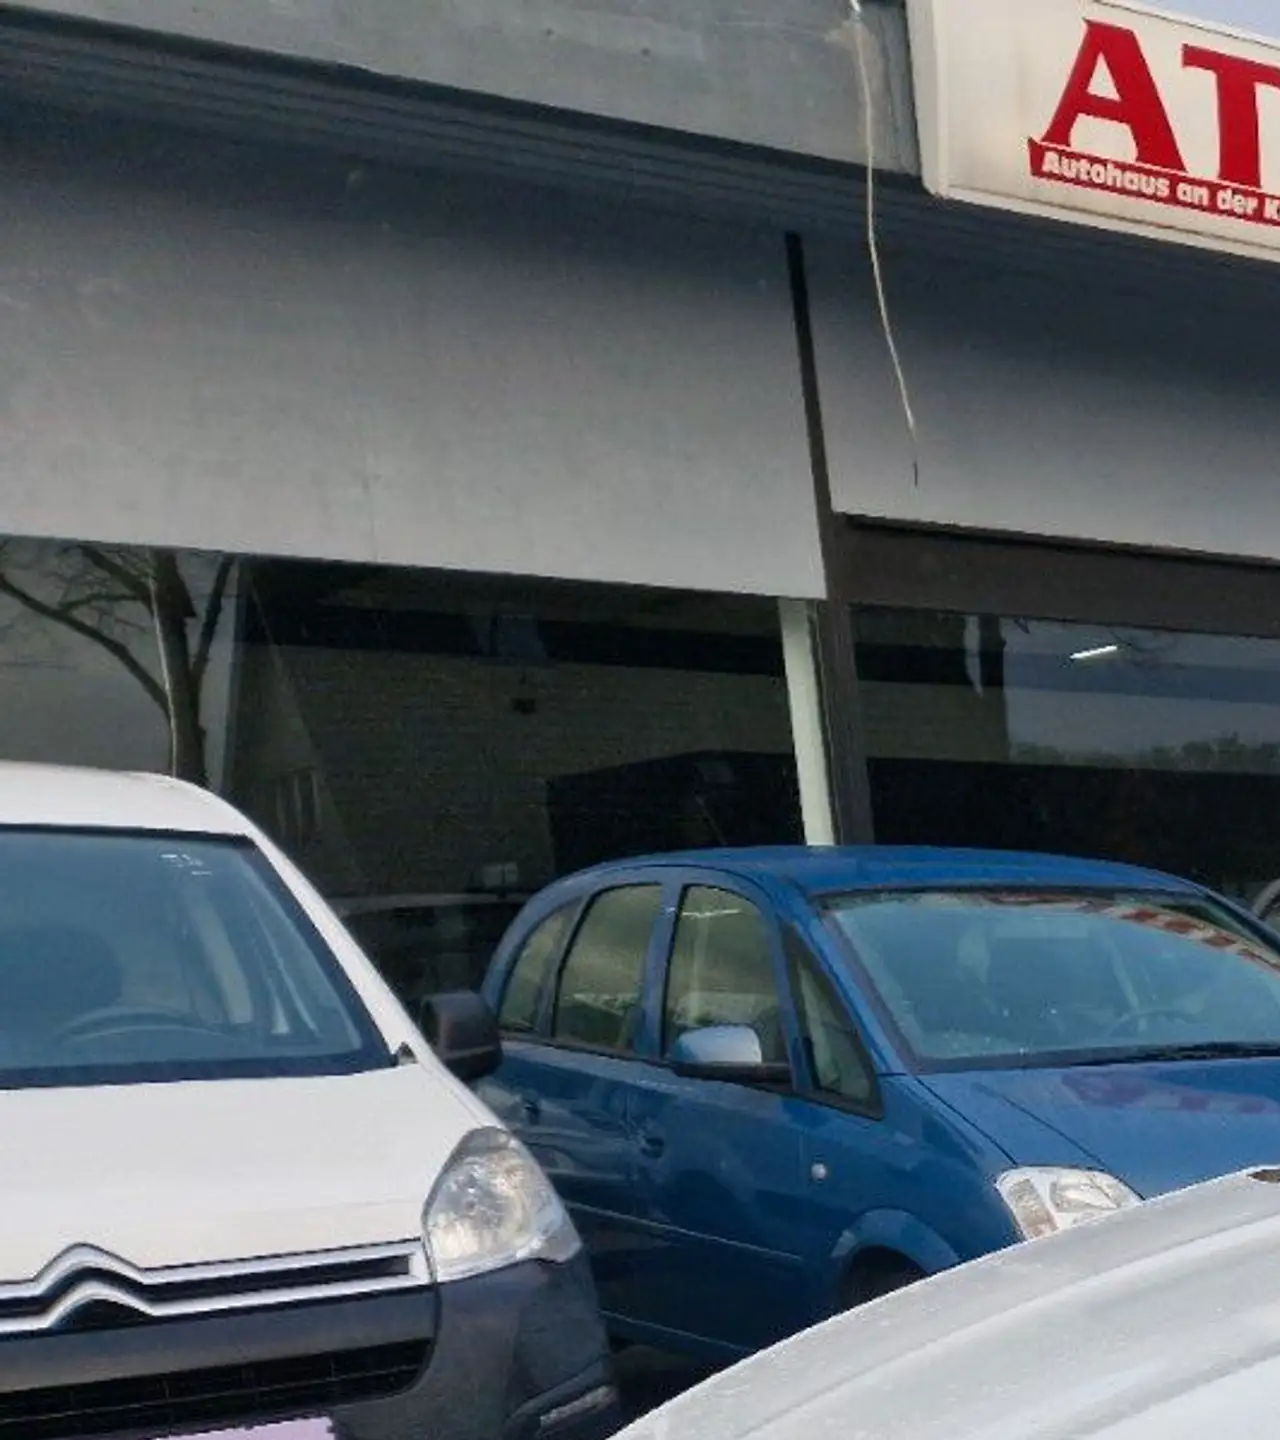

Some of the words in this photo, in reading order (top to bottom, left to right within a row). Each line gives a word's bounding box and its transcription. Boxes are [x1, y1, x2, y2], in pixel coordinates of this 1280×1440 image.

[1042, 151, 1170, 197] Autohaus
[1177, 179, 1209, 206] an
[1216, 188, 1258, 216] der
